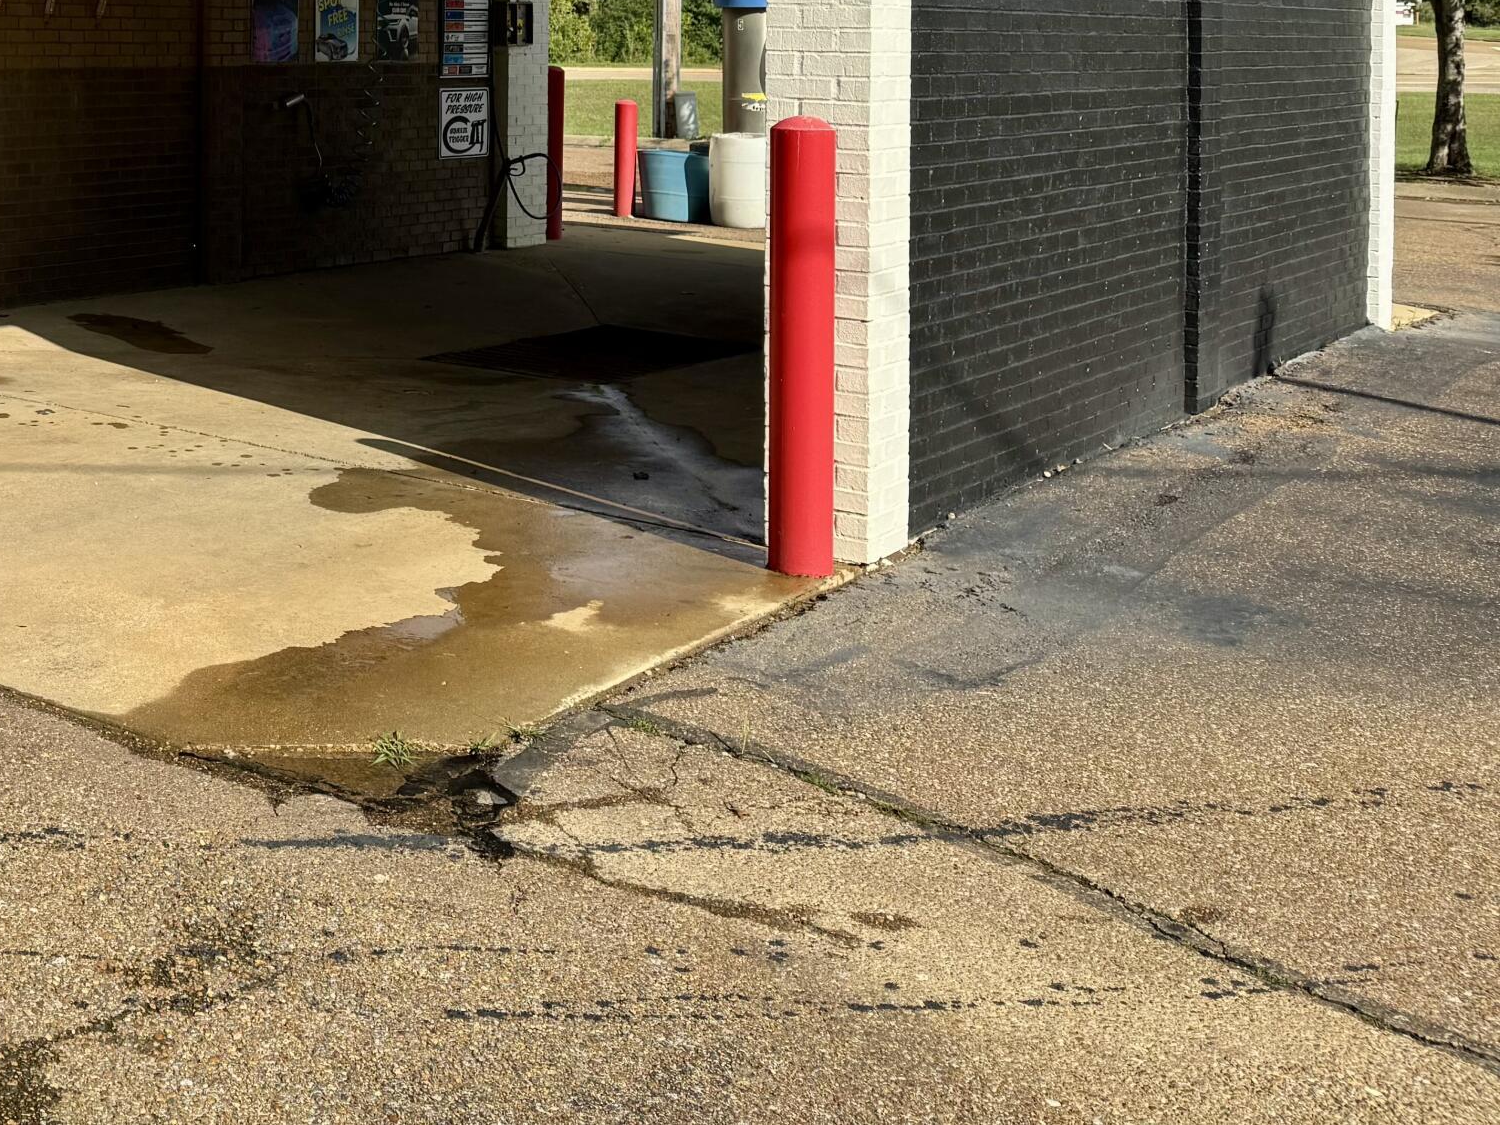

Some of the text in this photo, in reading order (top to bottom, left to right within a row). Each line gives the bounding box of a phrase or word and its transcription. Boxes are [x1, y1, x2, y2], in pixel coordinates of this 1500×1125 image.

[327, 9, 349, 27] FREE
[737, 18, 744, 31] 5
[445, 92, 484, 103] FOR HIGH
[445, 103, 485, 115] PRESSURE
[448, 135, 469, 143] TRIGGER
